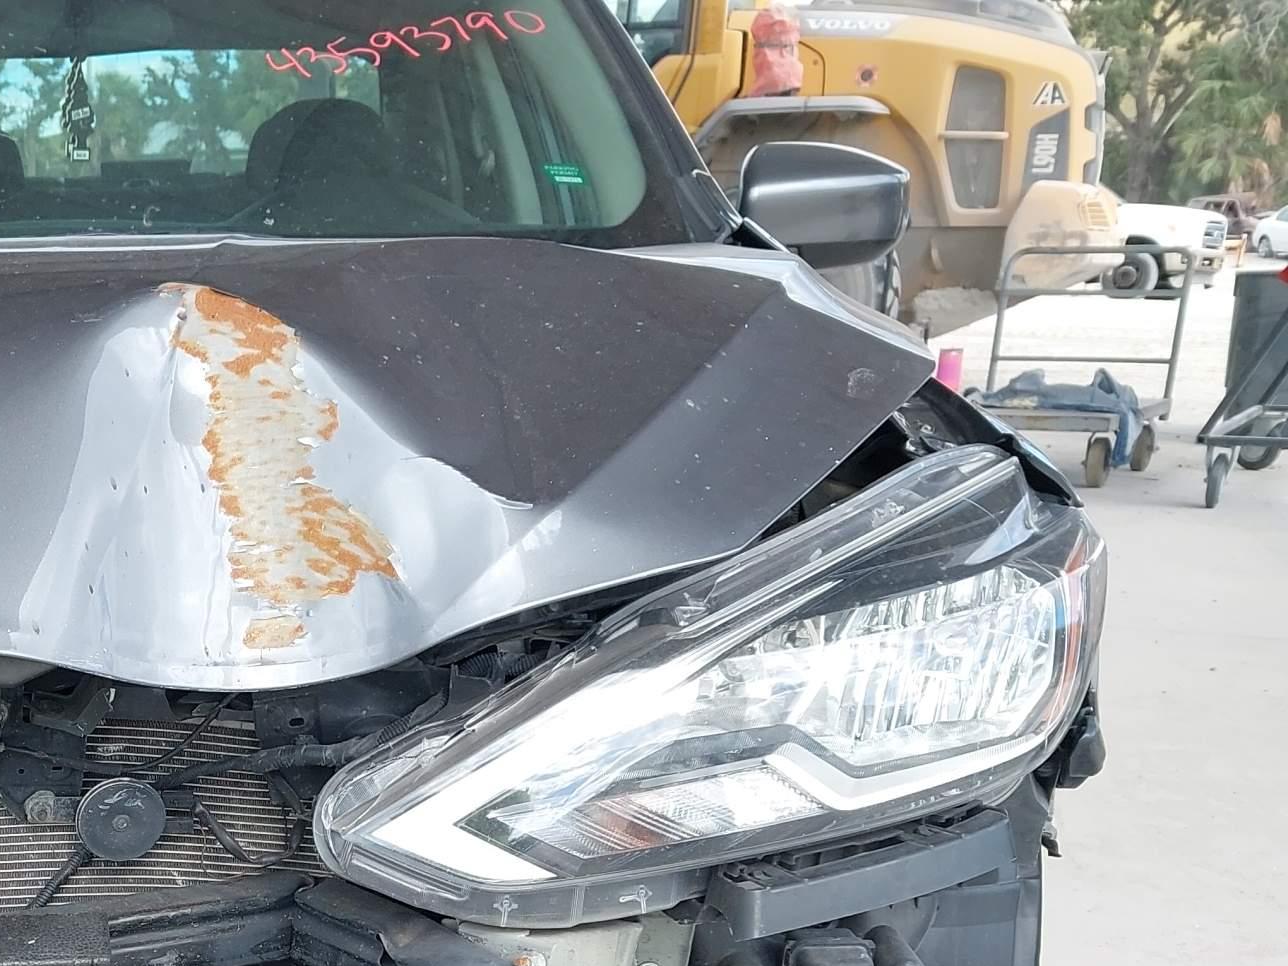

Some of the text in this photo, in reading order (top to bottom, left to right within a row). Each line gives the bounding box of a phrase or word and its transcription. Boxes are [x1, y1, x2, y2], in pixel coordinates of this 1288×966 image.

[266, 11, 546, 77] 43593790
[806, 17, 890, 30] VOLVO
[1031, 133, 1059, 174] L90H
